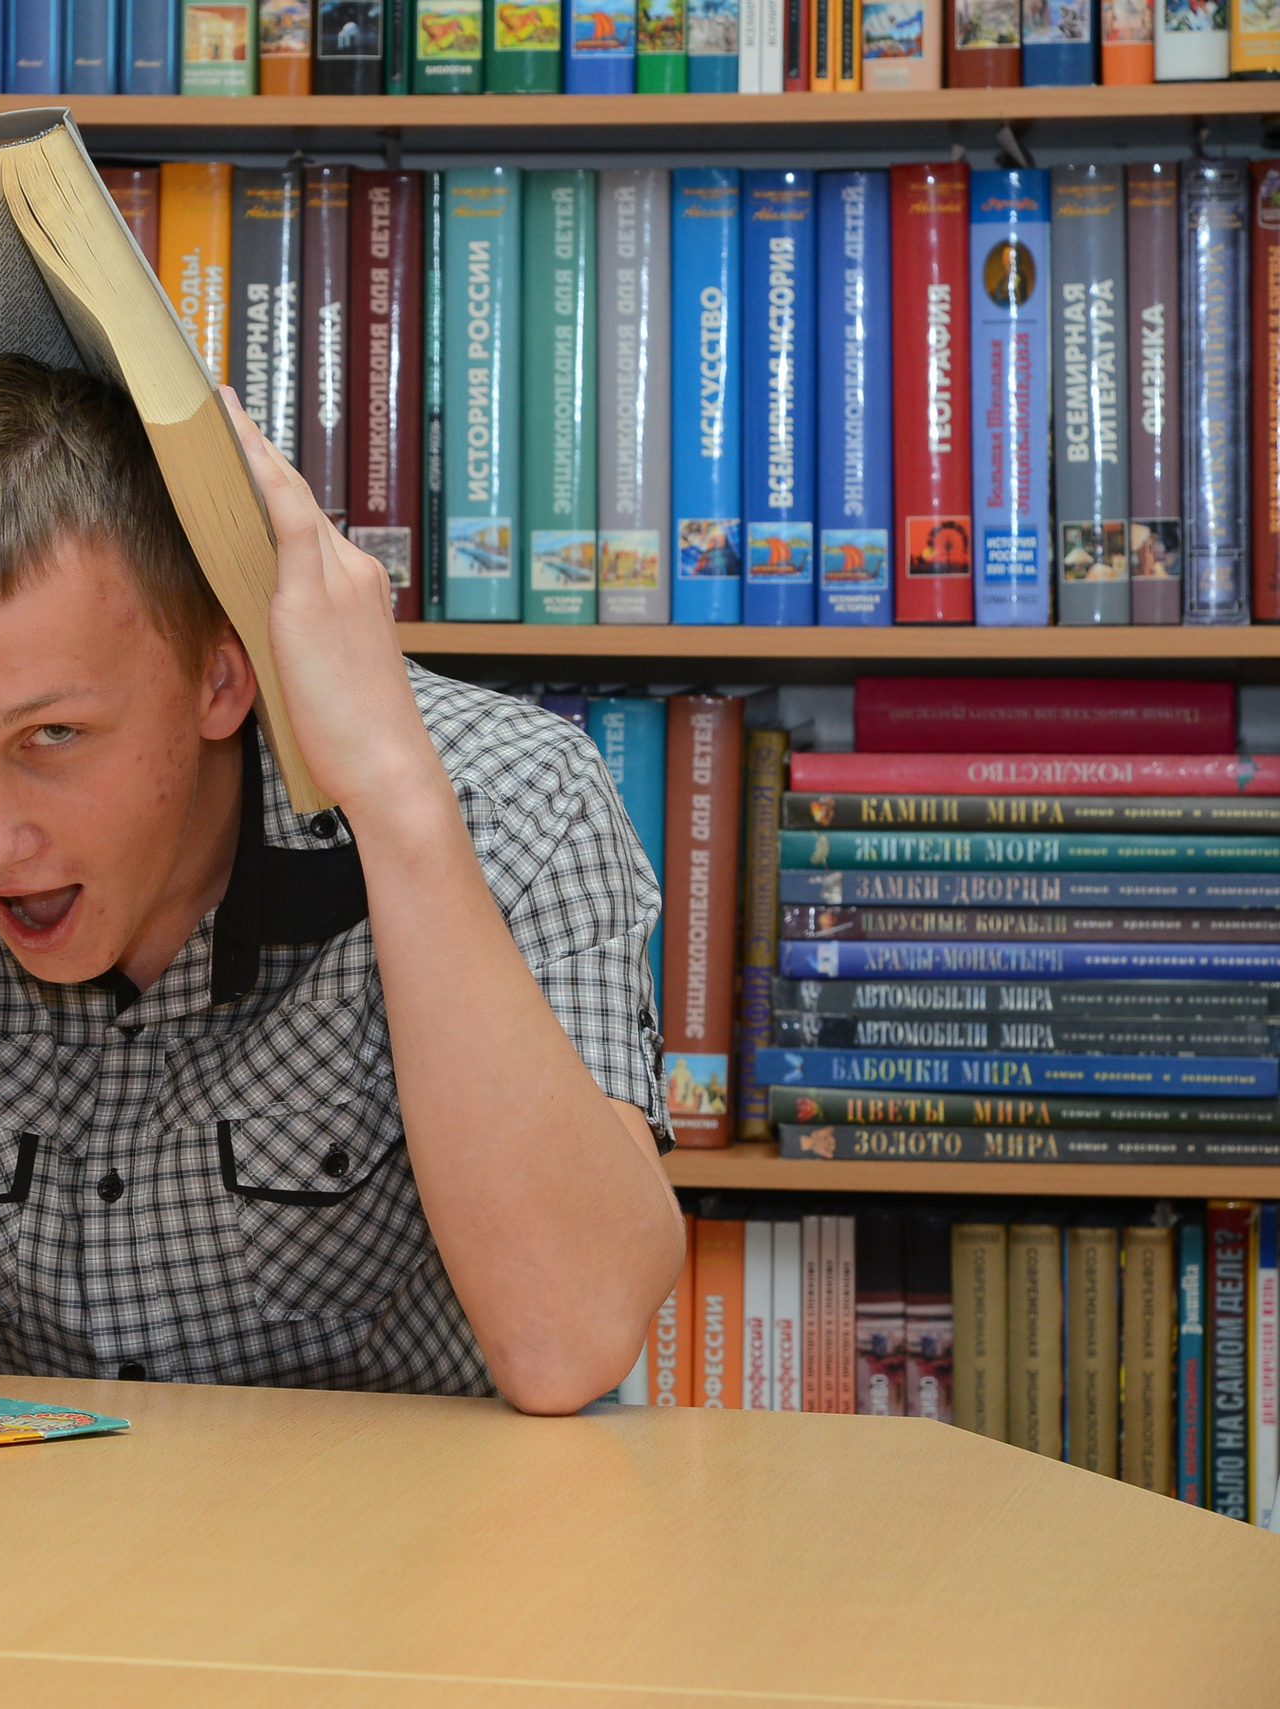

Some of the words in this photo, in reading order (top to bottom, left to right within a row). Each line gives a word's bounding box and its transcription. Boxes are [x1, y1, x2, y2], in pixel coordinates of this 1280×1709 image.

[369, 186, 391, 259] ДЕТЕЙ
[553, 186, 574, 260] ДЕТЕЙ
[616, 186, 637, 259] ДЕТЕЙ
[841, 185, 865, 259] ДЕТЕЙ
[468, 240, 490, 360] РОССИИ
[768, 236, 795, 353] ИСТОРИЯ
[245, 282, 269, 436] СЕМИРНАЯ
[271, 280, 297, 461] ЛИТЕРАТУРА
[317, 301, 342, 429] ФИЗИКА
[700, 286, 724, 458] ИСКУССТВО
[927, 283, 952, 454] ГЕОГРАФИЯ
[1063, 282, 1090, 463] ВСЕМИРНАЯ
[1091, 278, 1118, 465] ЛИТЕРАТУРА
[1141, 302, 1166, 435] ФИЗИКА
[367, 322, 389, 513] ЭНЦИКЛОПЕДИЯ
[468, 366, 490, 502] ИСТОРИЯ
[553, 323, 573, 515] ЭНЦИКЛОПЕДИЯ
[616, 323, 635, 514] ЭНЦИКЛОПЕДИЯ
[768, 357, 795, 509] ВСЕМИРНАЯ
[843, 324, 864, 517] ЭНЦИКЛОПЕДИЯ
[986, 536, 1037, 550] ИСТОРИЯ
[988, 549, 1034, 563] РОССИИ
[690, 712, 714, 786] ДЕТЕЙ
[967, 763, 1133, 784] РОЖДЕСТВО
[854, 838, 972, 863] ЖИТЕЛИ
[985, 839, 1060, 863] МОРЯ
[860, 798, 960, 823] КАМНИ
[986, 799, 1065, 825] МИРА
[685, 849, 712, 1040] ЭНЦИКЛОПЕДИЯ
[861, 912, 968, 933] ПАРУСНЫЕ
[975, 913, 1068, 934] КОРАБЛИ
[852, 985, 987, 1011] АВТОМОБИЛИ
[998, 986, 1054, 1012] МИРА
[854, 1021, 988, 1048] АВТОМОБИЛИ
[1000, 1023, 1055, 1049] МИРА
[832, 1056, 950, 1084] БАБОЧКИ
[961, 1060, 1033, 1086] МИРА
[846, 1098, 947, 1124] ЦВЕТЫ
[972, 1100, 1052, 1125] МИРА
[854, 1130, 963, 1158] ЗОЛОТО
[984, 1132, 1060, 1159] МИРА
[1213, 1228, 1245, 1319] ДЕЛЕ?
[703, 1295, 724, 1409] ОФЕССИИ
[776, 1318, 793, 1411] рофессий
[1216, 1319, 1245, 1412] САМОМ
[1216, 1415, 1245, 1449] НА
[1216, 1454, 1246, 1523] БЫЛО
